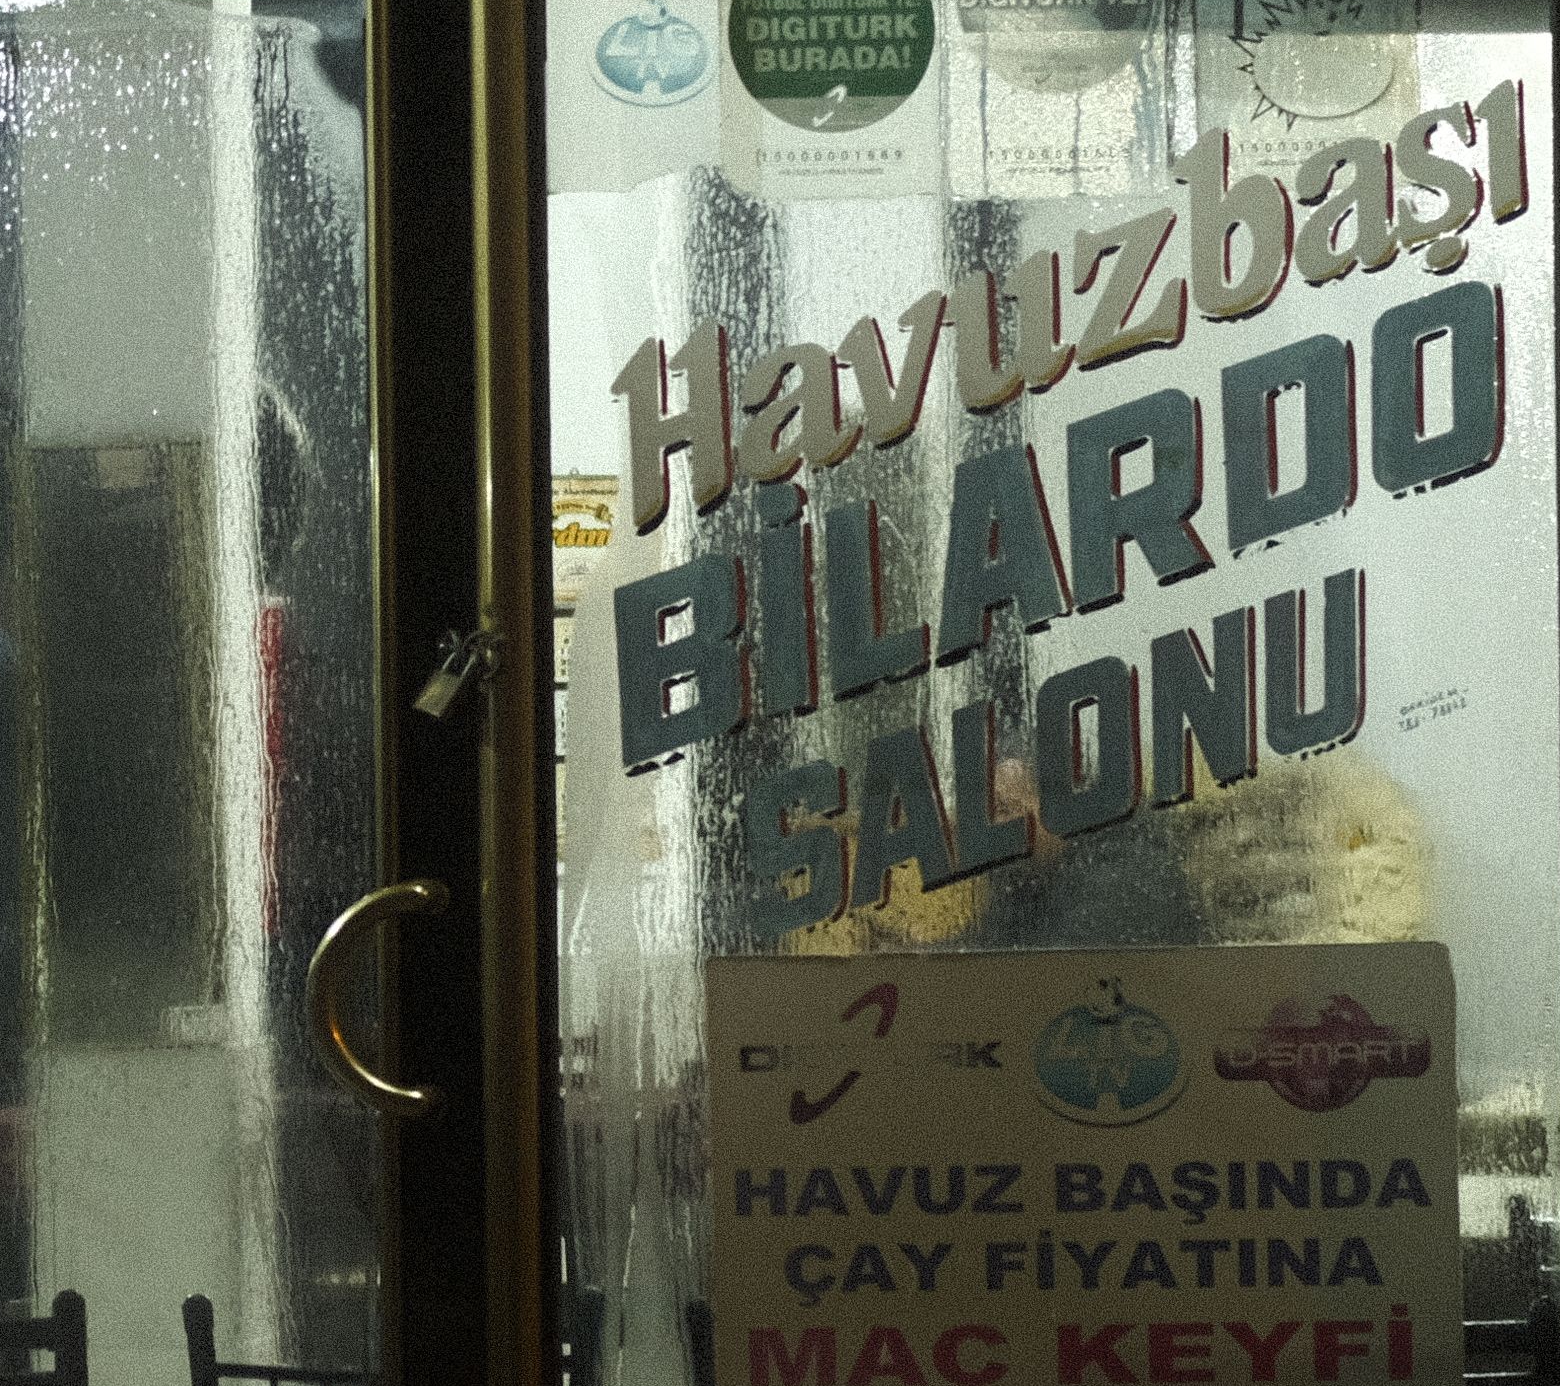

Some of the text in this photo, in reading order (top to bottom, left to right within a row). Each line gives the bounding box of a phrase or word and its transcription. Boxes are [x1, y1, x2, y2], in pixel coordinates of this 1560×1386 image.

[745, 14, 919, 42] DIGITURK
[753, 44, 912, 73] BURADA!
[608, 77, 1529, 537] Havuzbaşı
[613, 280, 1506, 777] BİLARDO
[737, 565, 1367, 939] SALONU
[1227, 1038, 1418, 1069] D-SMART
[733, 1158, 1431, 1225] HAVUZ BAŞINDA
[784, 1229, 1383, 1307] ÇAY FİYATINA
[1056, 1303, 1414, 1385] KEYFİ
